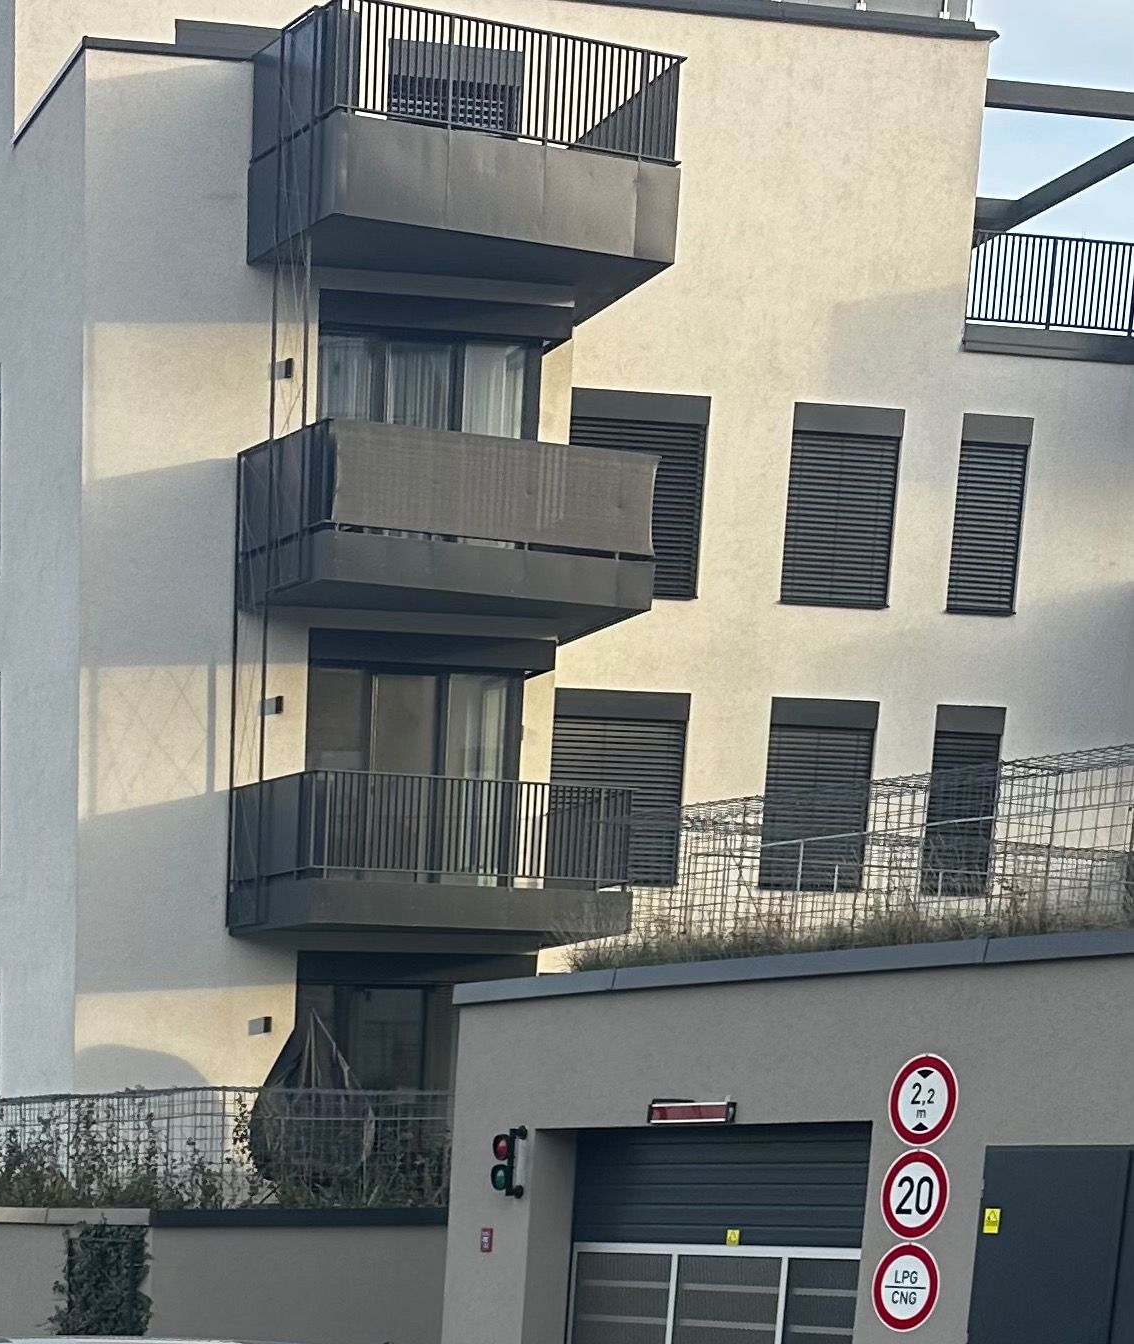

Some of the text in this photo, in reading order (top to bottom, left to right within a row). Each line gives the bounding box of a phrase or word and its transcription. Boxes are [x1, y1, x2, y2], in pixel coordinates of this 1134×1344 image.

[911, 1082, 935, 1106] 2,2
[916, 1109, 927, 1119] m
[895, 1175, 934, 1216] 20
[894, 1269, 918, 1285] LPG
[891, 1290, 917, 1306] CNG
